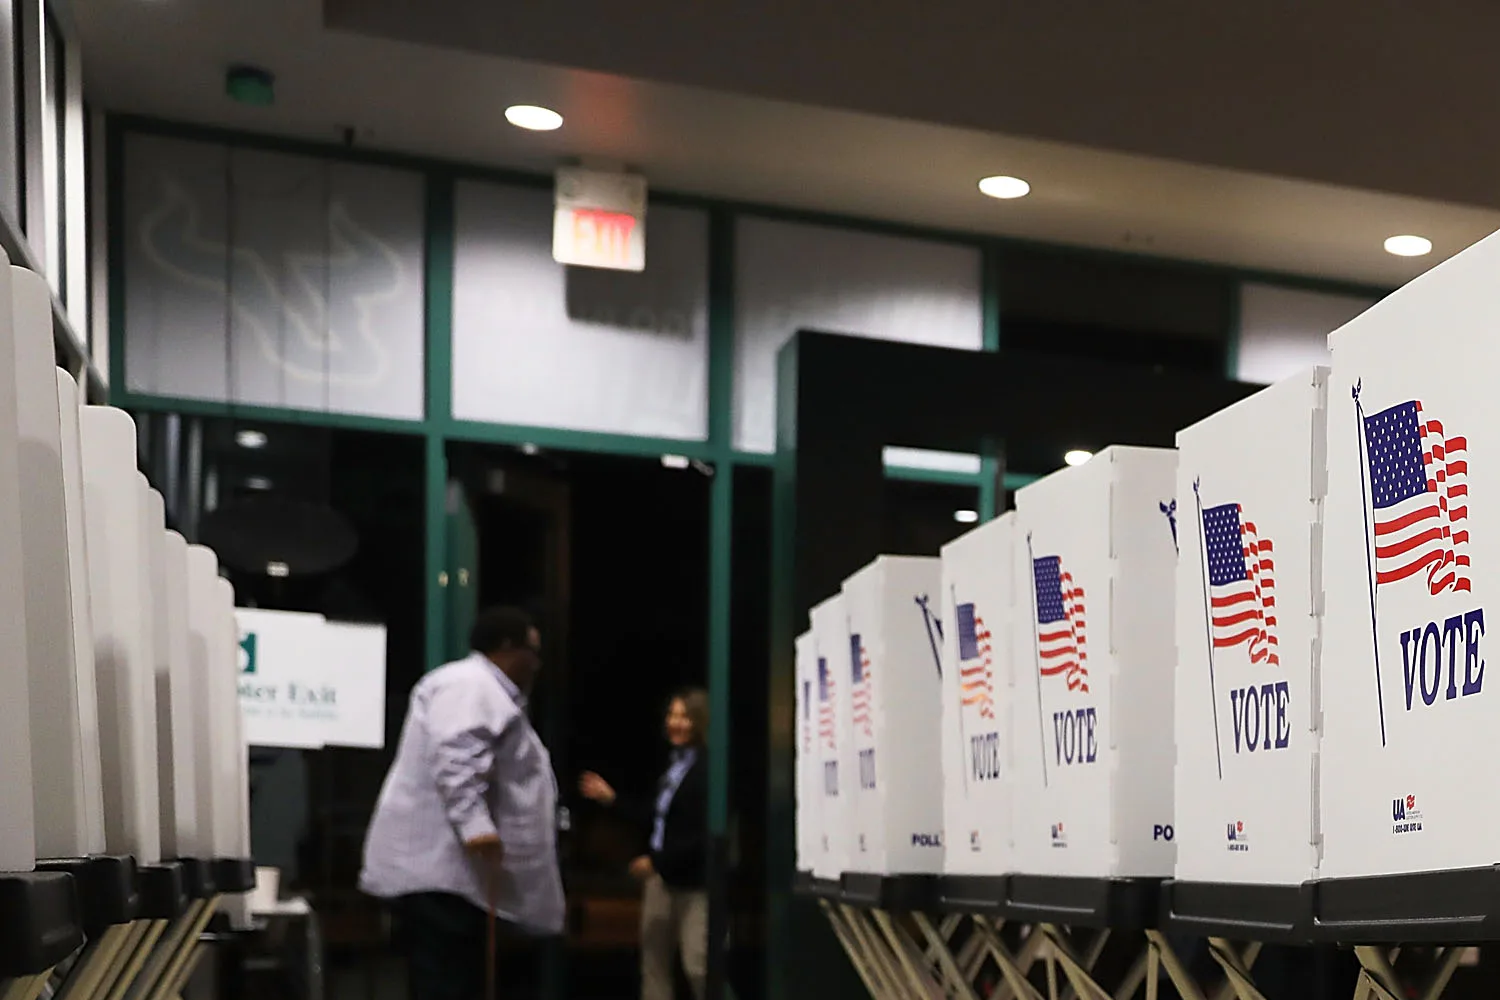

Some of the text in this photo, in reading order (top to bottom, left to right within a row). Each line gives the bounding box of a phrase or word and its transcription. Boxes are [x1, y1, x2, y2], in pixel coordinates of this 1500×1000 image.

[571, 207, 636, 263] EXIT
[1399, 607, 1486, 711] VOTE
[237, 683, 276, 702] oter
[1230, 681, 1291, 754] VOTE
[971, 732, 1000, 780] VOTE
[1053, 707, 1097, 766] VOTE
[1153, 823, 1174, 842] PO
[1392, 798, 1406, 822] UA
